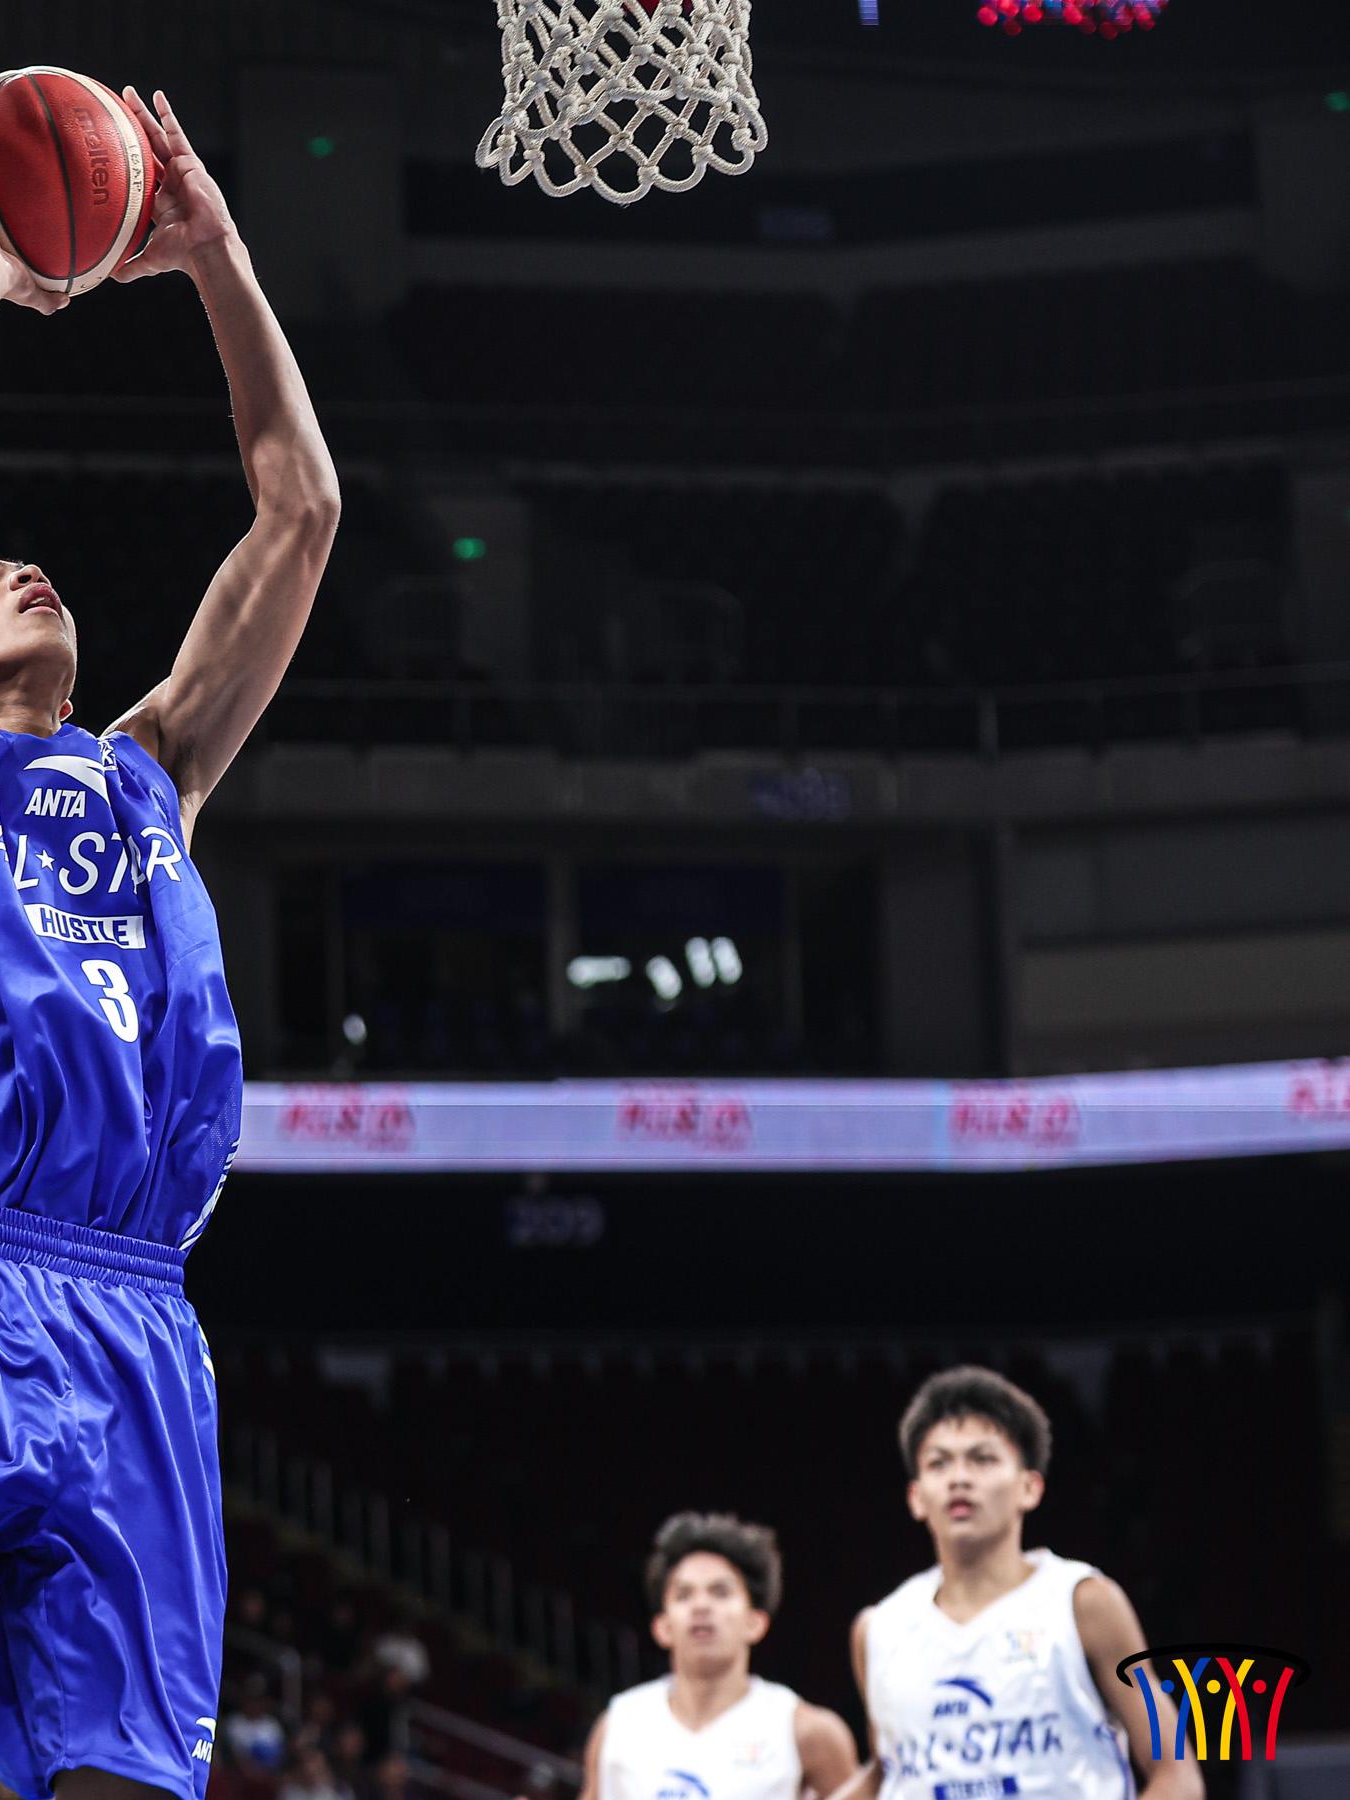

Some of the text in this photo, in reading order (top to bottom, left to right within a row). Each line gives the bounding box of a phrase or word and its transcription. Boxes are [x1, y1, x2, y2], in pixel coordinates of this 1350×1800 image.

[24, 787, 86, 818] ANTA
[40, 907, 128, 946] HUSTLE
[80, 959, 139, 1043] 3
